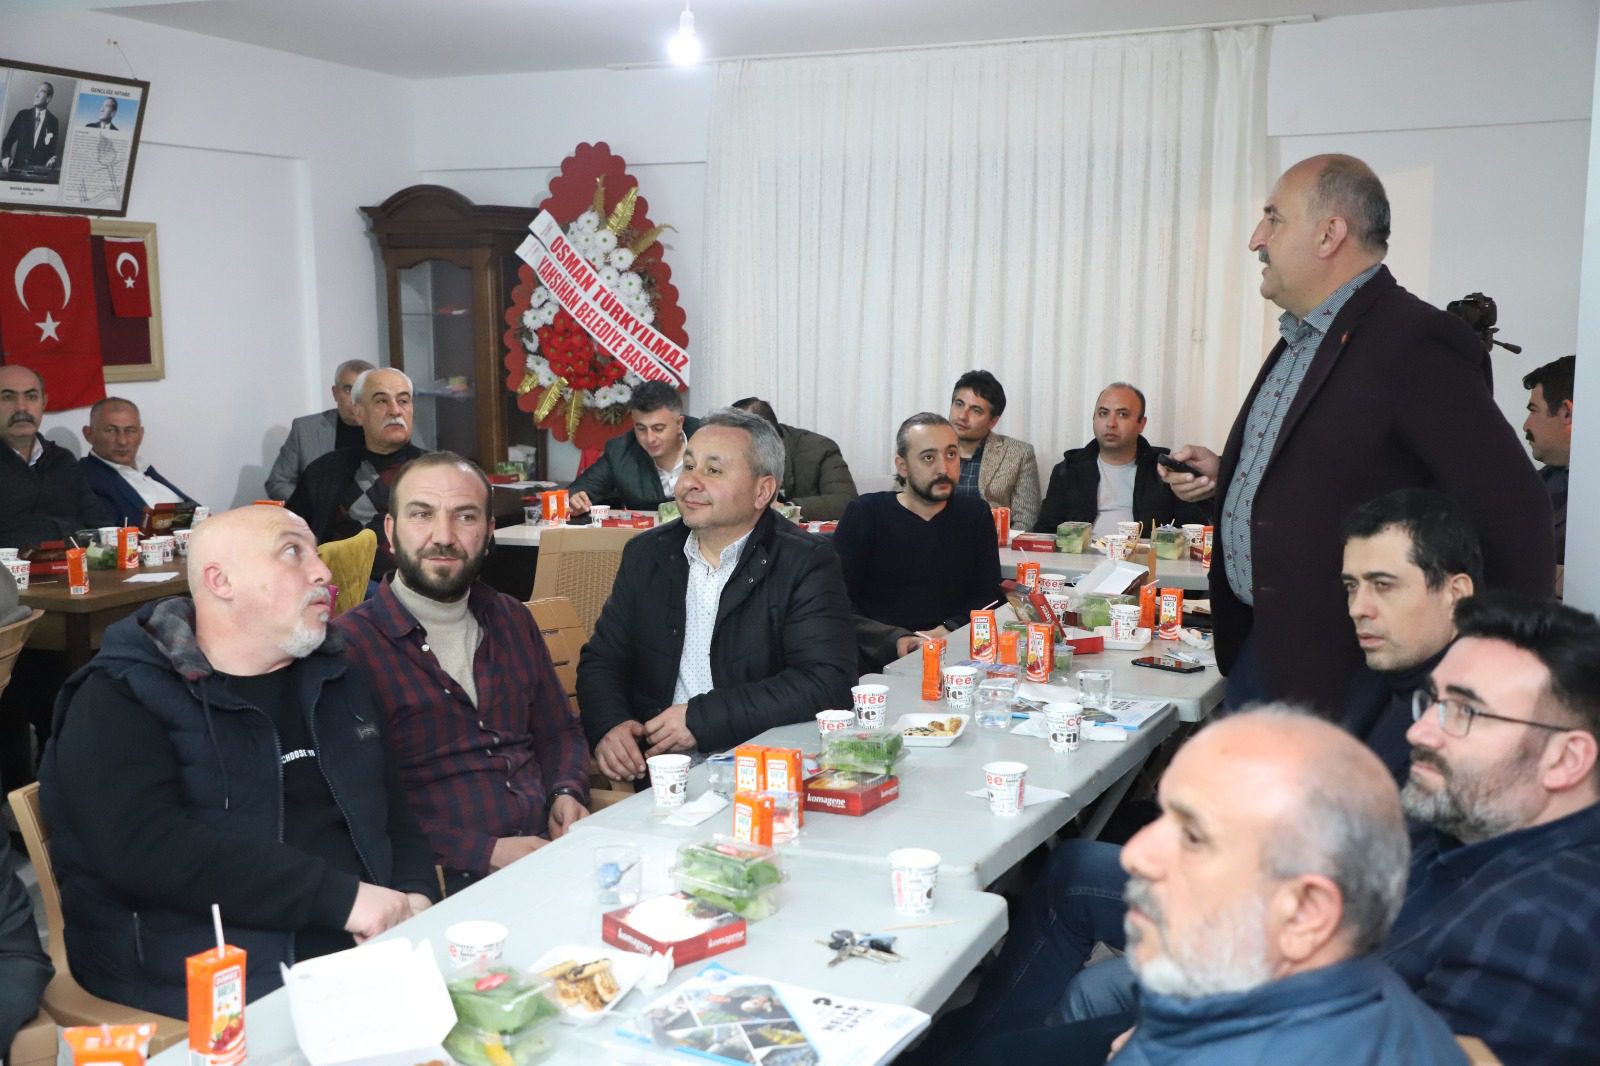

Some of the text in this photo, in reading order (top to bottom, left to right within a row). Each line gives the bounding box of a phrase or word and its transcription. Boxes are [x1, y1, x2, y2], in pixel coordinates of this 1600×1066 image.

[550, 235, 689, 373] OSMAN TÜRKYILMAZ
[575, 301, 627, 349] BELEDİYE
[281, 749, 307, 764] CHOOSE
[806, 792, 846, 807] komagene
